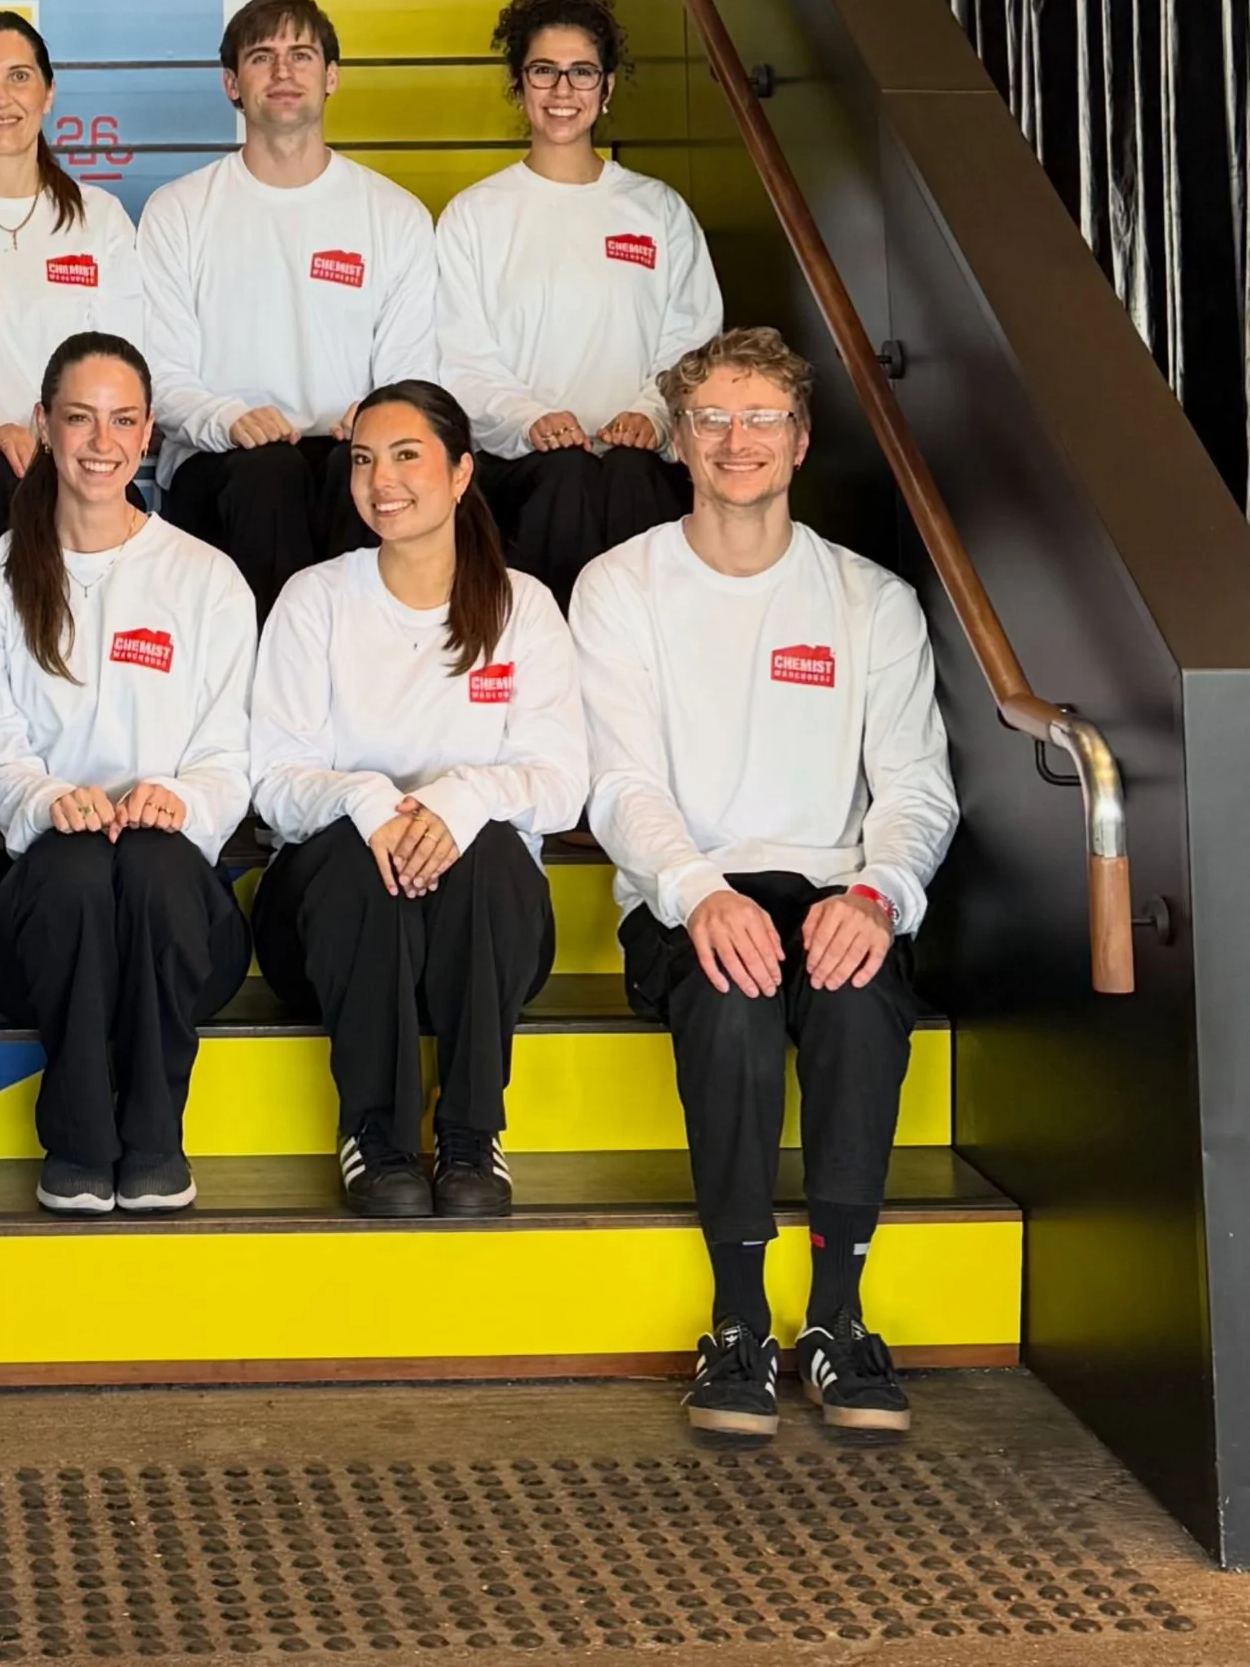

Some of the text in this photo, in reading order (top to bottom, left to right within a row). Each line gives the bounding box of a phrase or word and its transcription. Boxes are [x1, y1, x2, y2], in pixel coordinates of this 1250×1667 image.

[54, 115, 134, 166] 26
[49, 263, 96, 277] CHEMIST
[314, 257, 362, 277] CHEMIST
[114, 638, 170, 659] CHEMIST
[774, 655, 832, 674] CHEMIST
